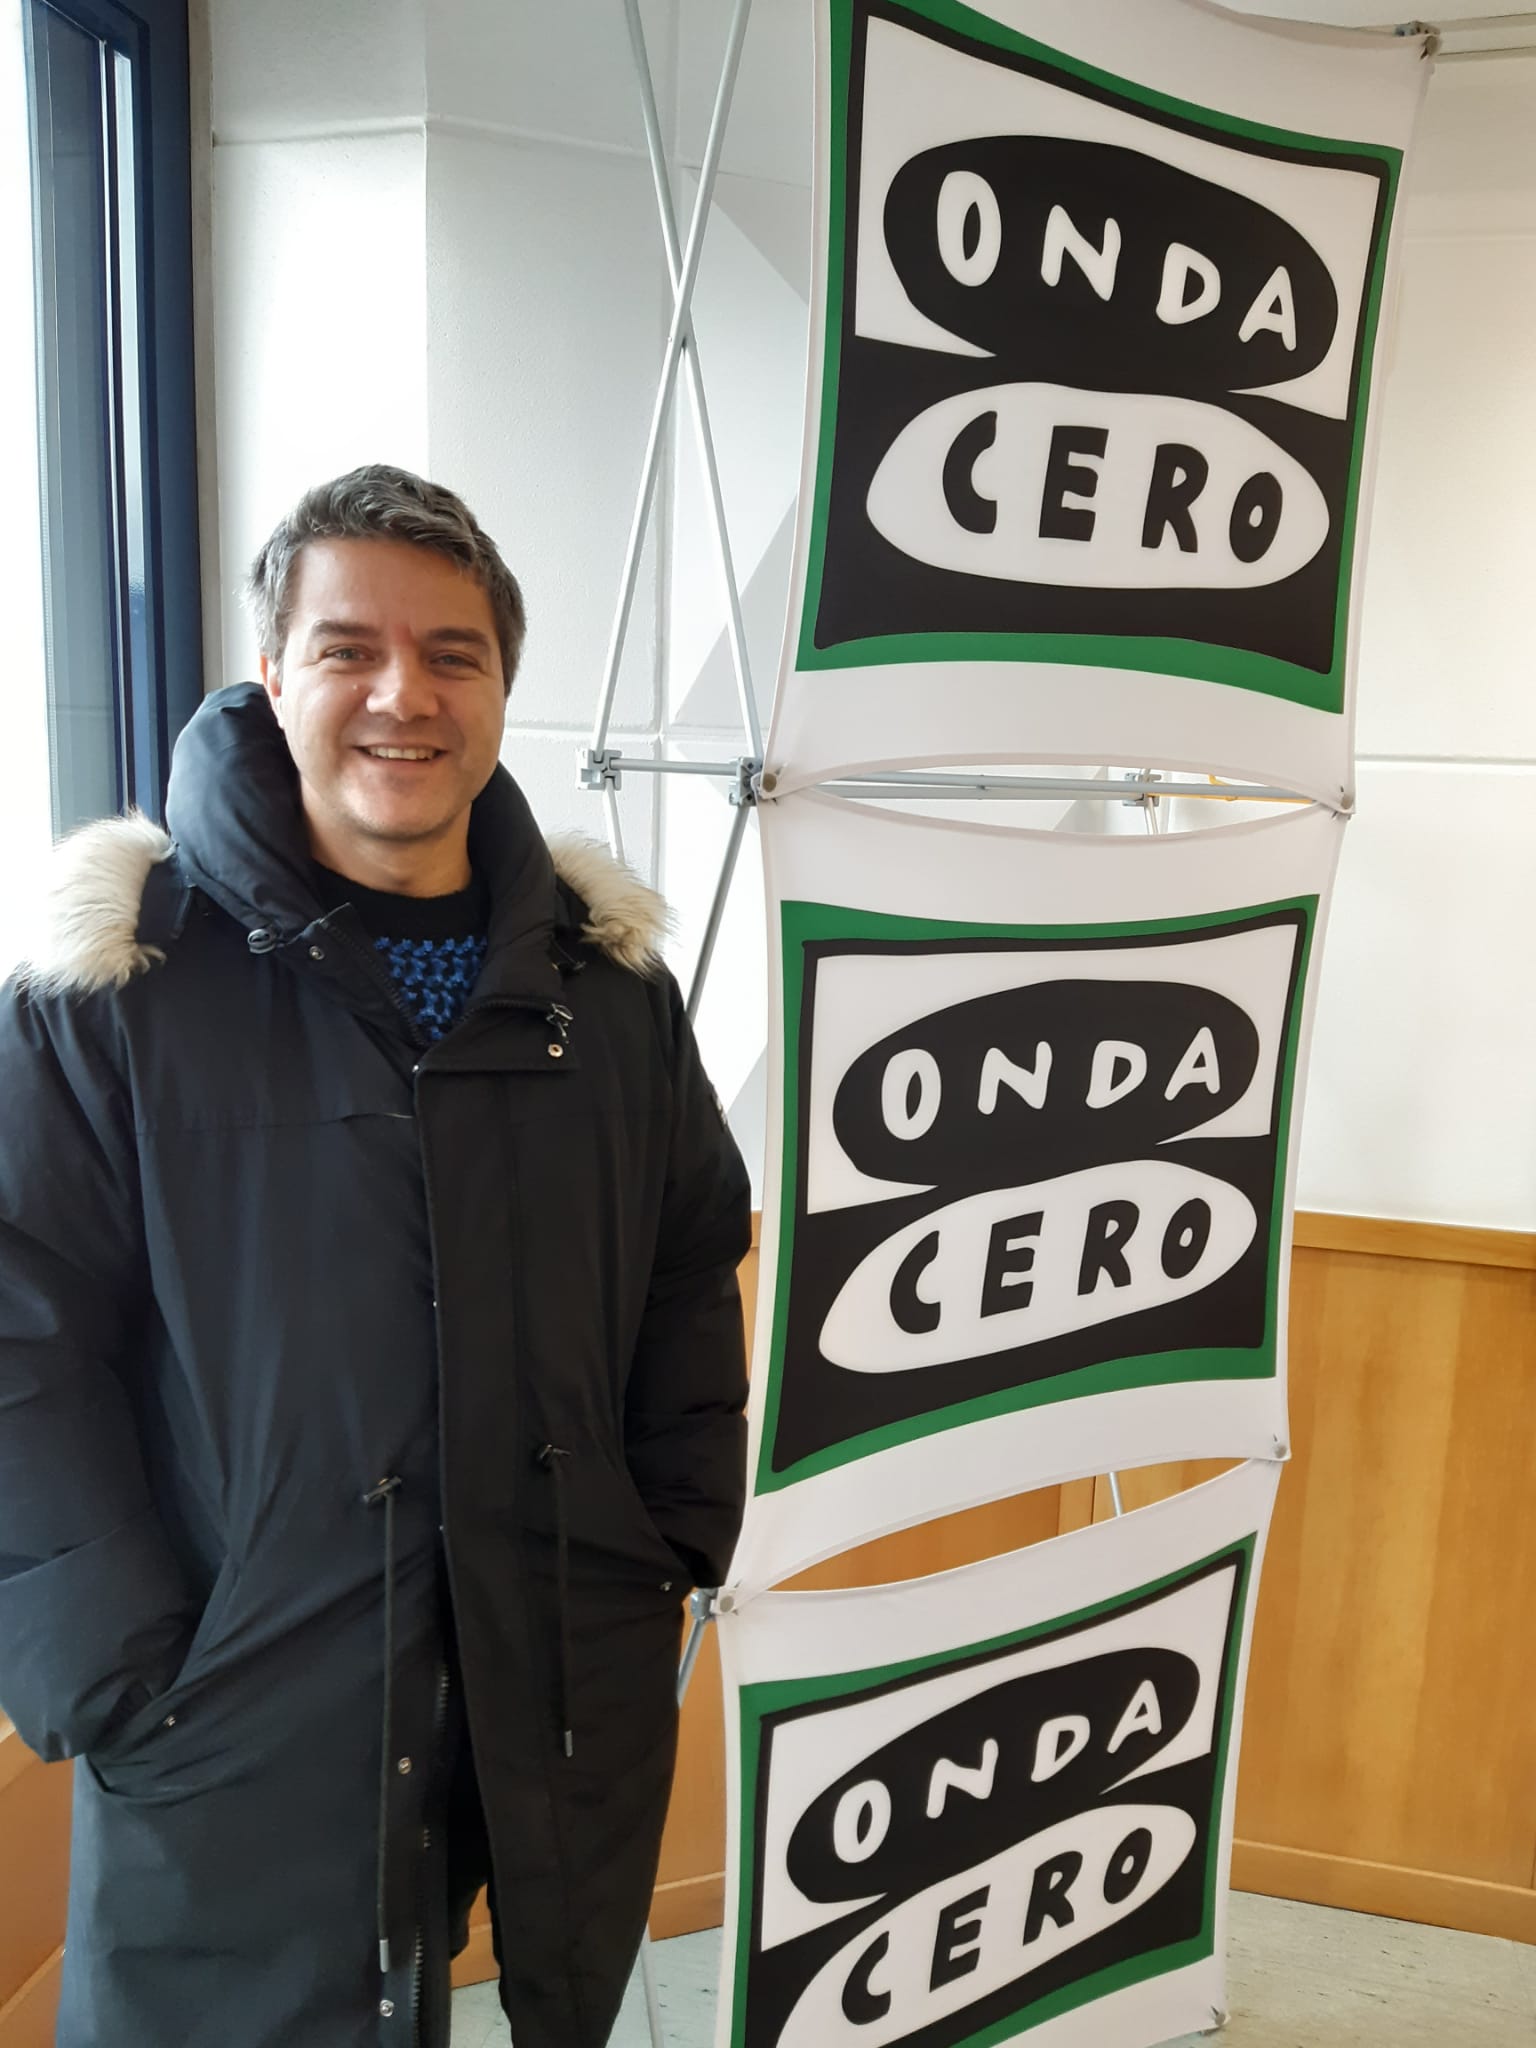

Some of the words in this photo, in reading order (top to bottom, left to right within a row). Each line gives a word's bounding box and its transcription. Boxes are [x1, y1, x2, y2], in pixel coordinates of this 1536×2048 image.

[937, 171, 1297, 352] ONDA
[942, 410, 1283, 563] CERO
[881, 1027, 1220, 1140] ONDA
[889, 1198, 1211, 1335] CERO
[833, 1680, 1162, 1864] ONDA
[841, 1828, 1153, 2026] CERO
